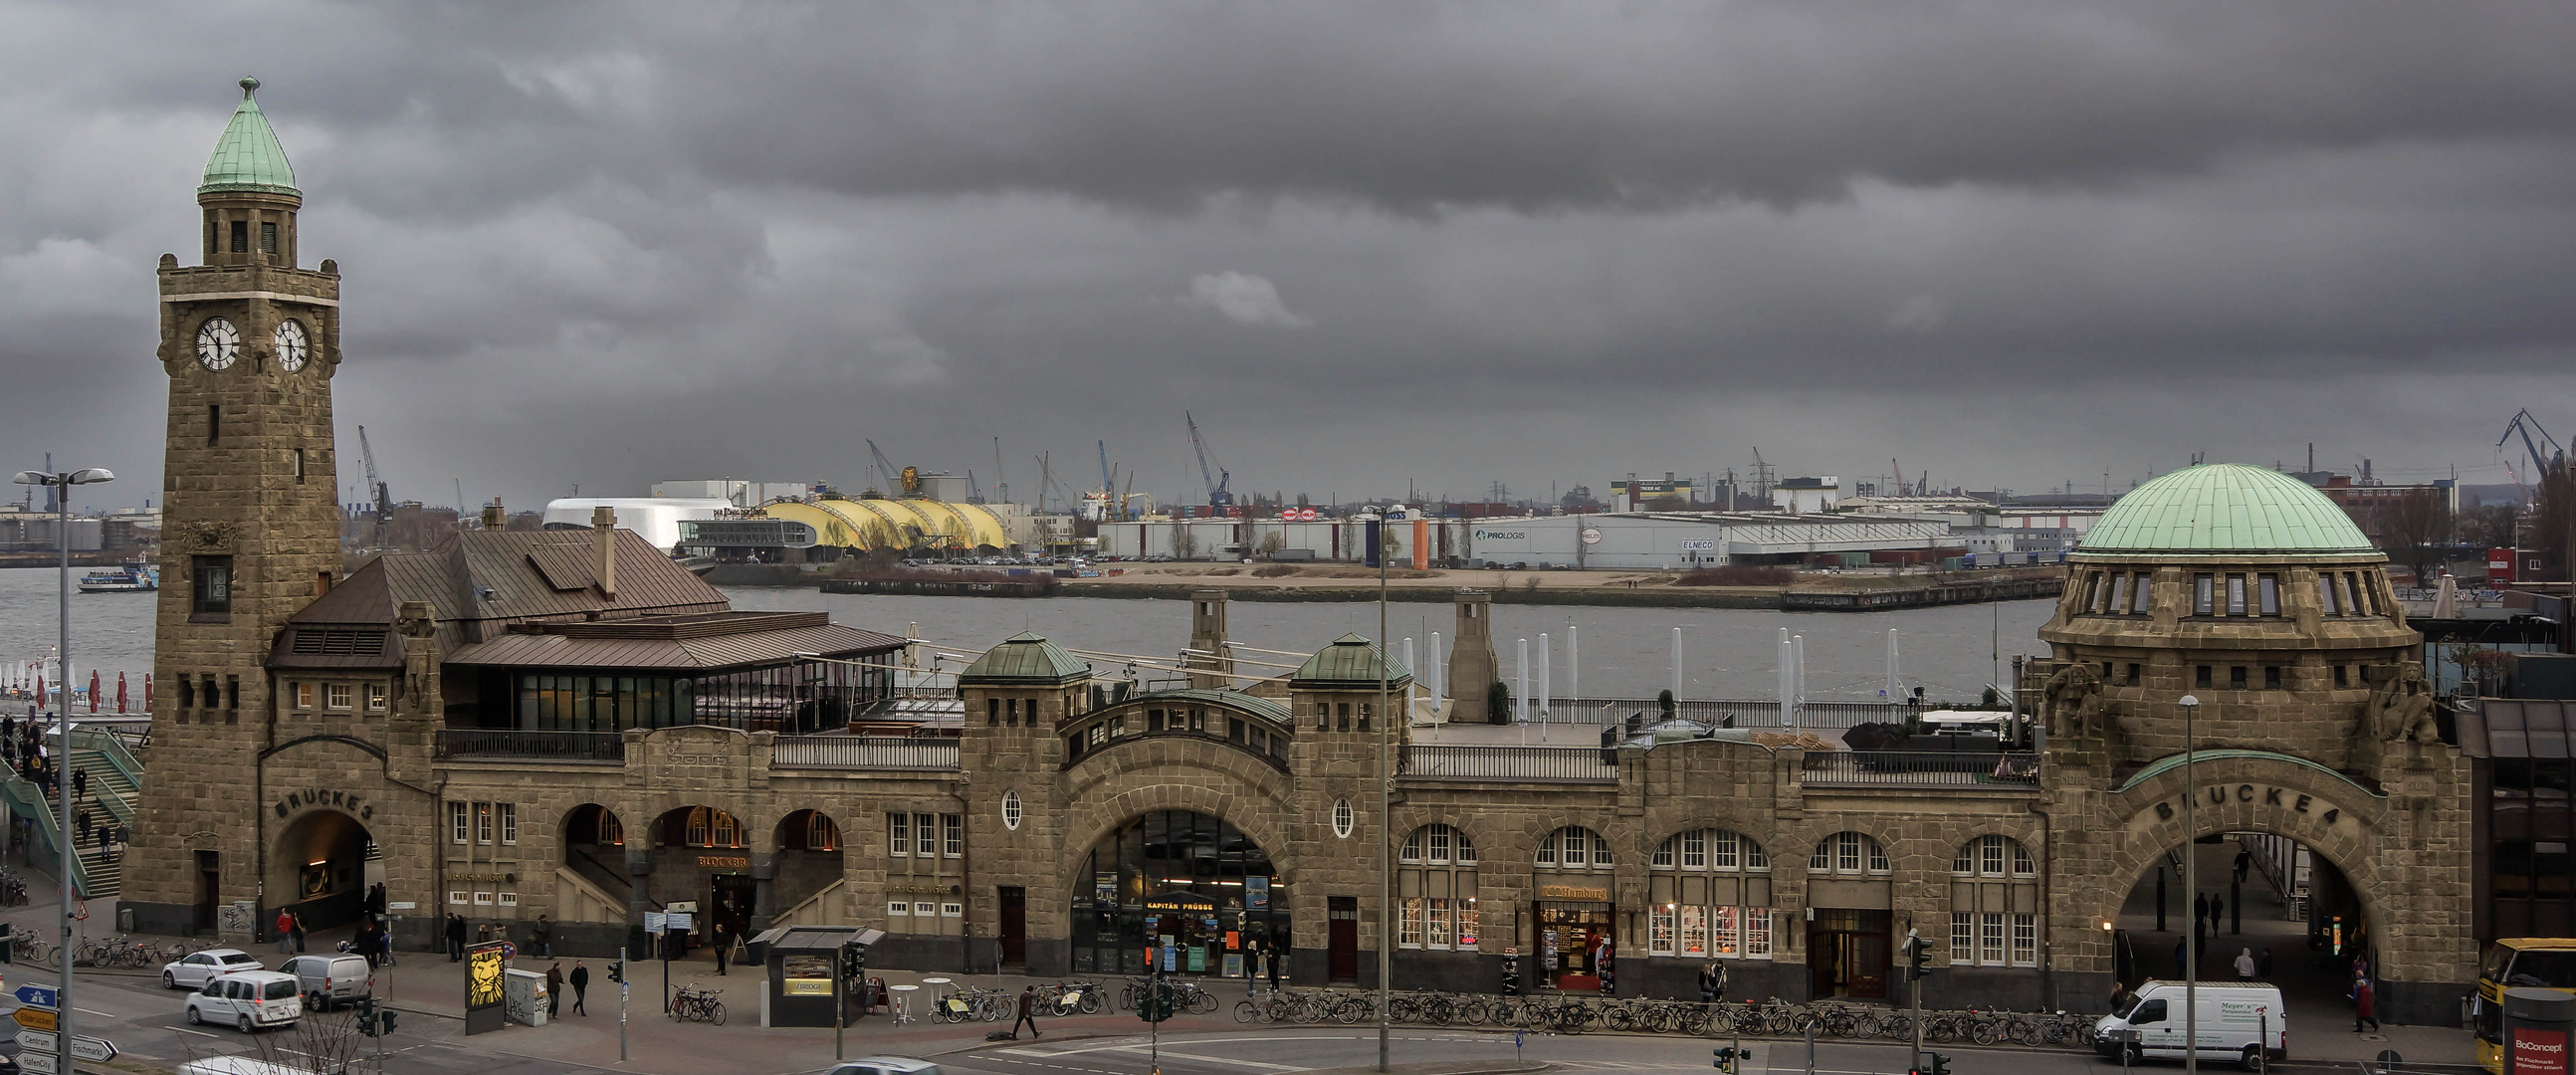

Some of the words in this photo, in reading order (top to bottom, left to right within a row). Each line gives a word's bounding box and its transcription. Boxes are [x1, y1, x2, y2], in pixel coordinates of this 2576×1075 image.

[360, 804, 373, 819] 3
[2324, 808, 2340, 824] 4
[1563, 887, 1608, 900] Hamburg
[1182, 902, 1213, 911] PRÜSSE
[25, 1035, 50, 1047] Centrum
[2515, 1040, 2562, 1054] BoConcept
[73, 1043, 103, 1056] Fischmarkt
[24, 1056, 51, 1070] HafenCity
